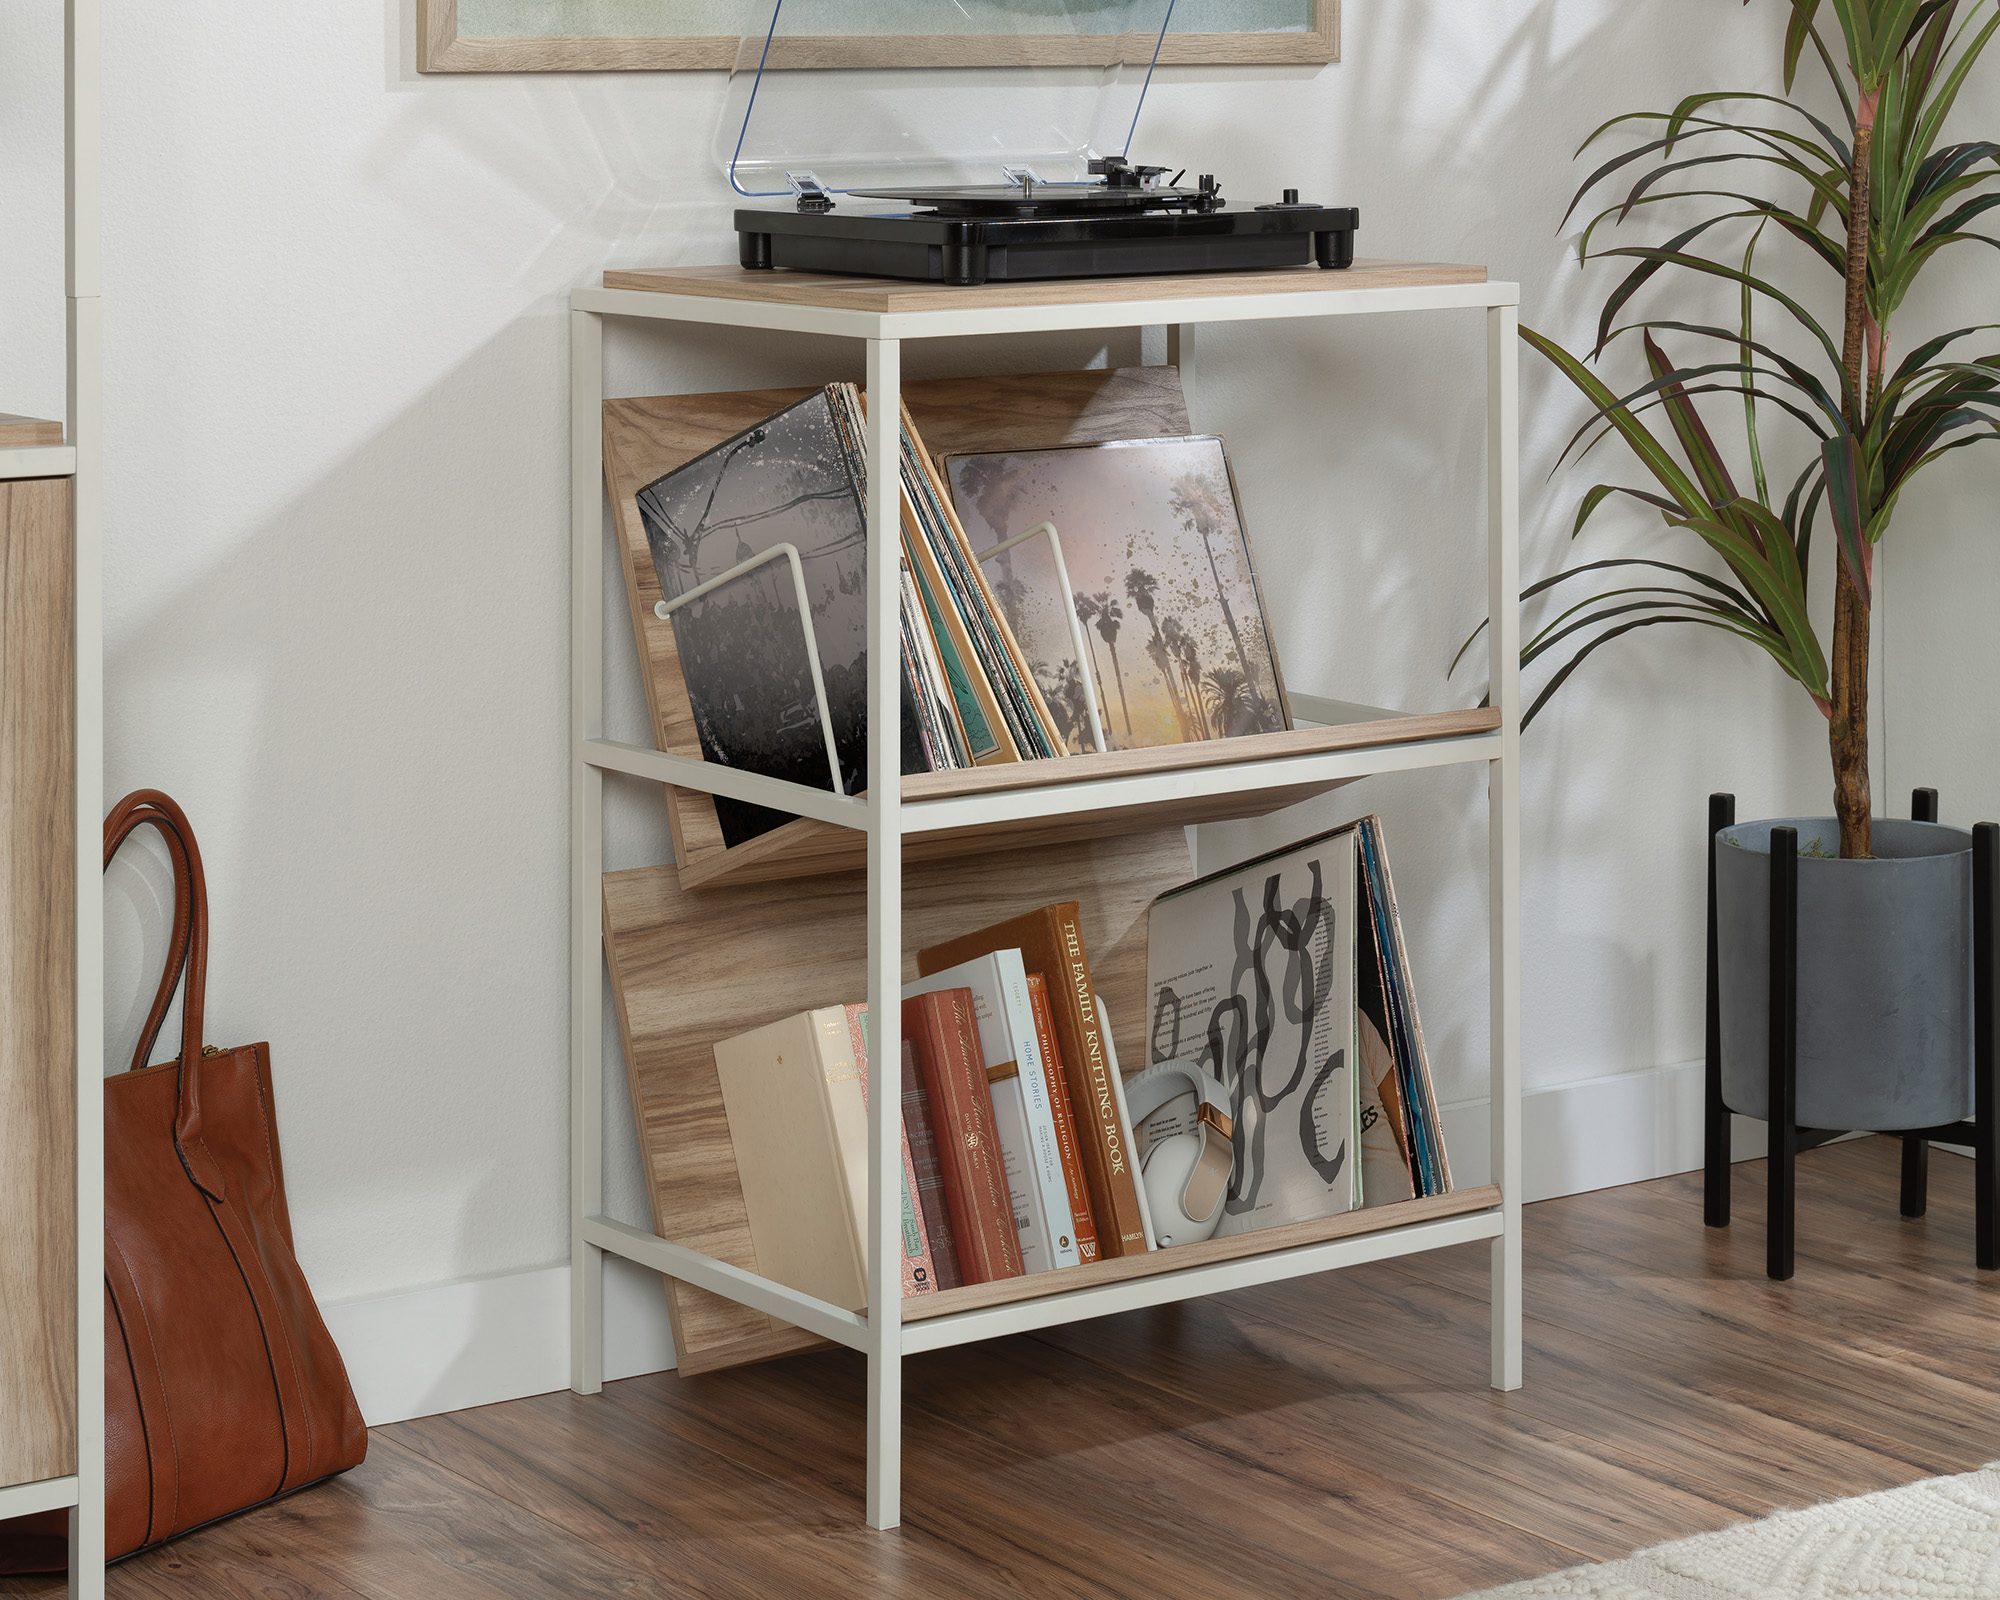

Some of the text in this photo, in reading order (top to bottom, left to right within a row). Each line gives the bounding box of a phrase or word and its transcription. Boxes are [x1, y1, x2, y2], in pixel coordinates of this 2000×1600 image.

[952, 1000, 967, 1026] The
[826, 1062, 856, 1077] CAPTAIN
[958, 1030, 976, 1092] American
[1024, 1040, 1043, 1110] HOME STORIES
[1064, 920, 1125, 1176] THE FAMILY KNITTING BOOK
[964, 1112, 972, 1132] DAVID
[971, 1096, 988, 1142] Heart
[1041, 1034, 1058, 1094] PHILOSOPHY
[1054, 1098, 1061, 1110] OF
[1058, 1112, 1072, 1160] RELIGION
[980, 1140, 1000, 1207] Association
[996, 1211, 1020, 1276] Cookbook
[1121, 1232, 1144, 1242] HAMLYN
